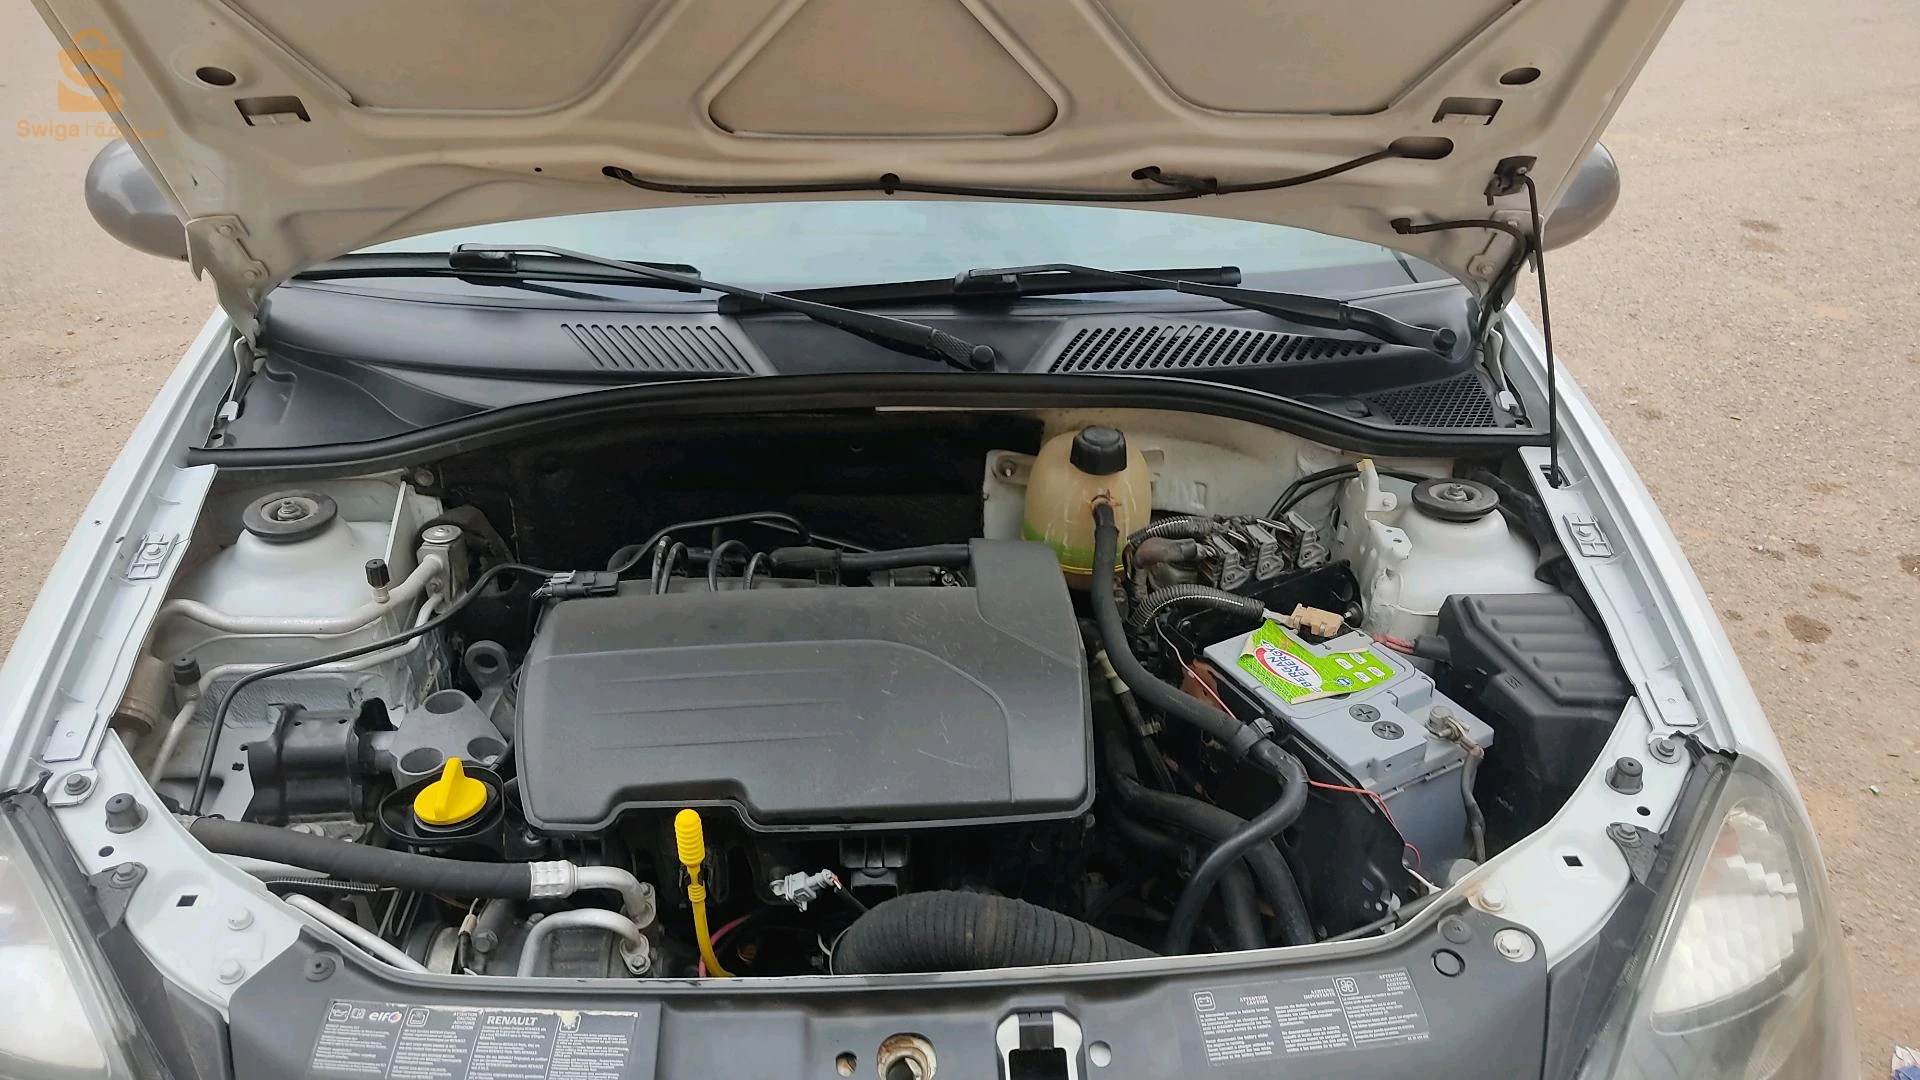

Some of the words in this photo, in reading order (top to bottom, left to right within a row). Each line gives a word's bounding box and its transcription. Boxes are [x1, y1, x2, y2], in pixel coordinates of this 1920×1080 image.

[1267, 657, 1312, 688] BERGAN
[1268, 648, 1310, 677] ENERGY
[487, 1015, 538, 1026] RENAULT
